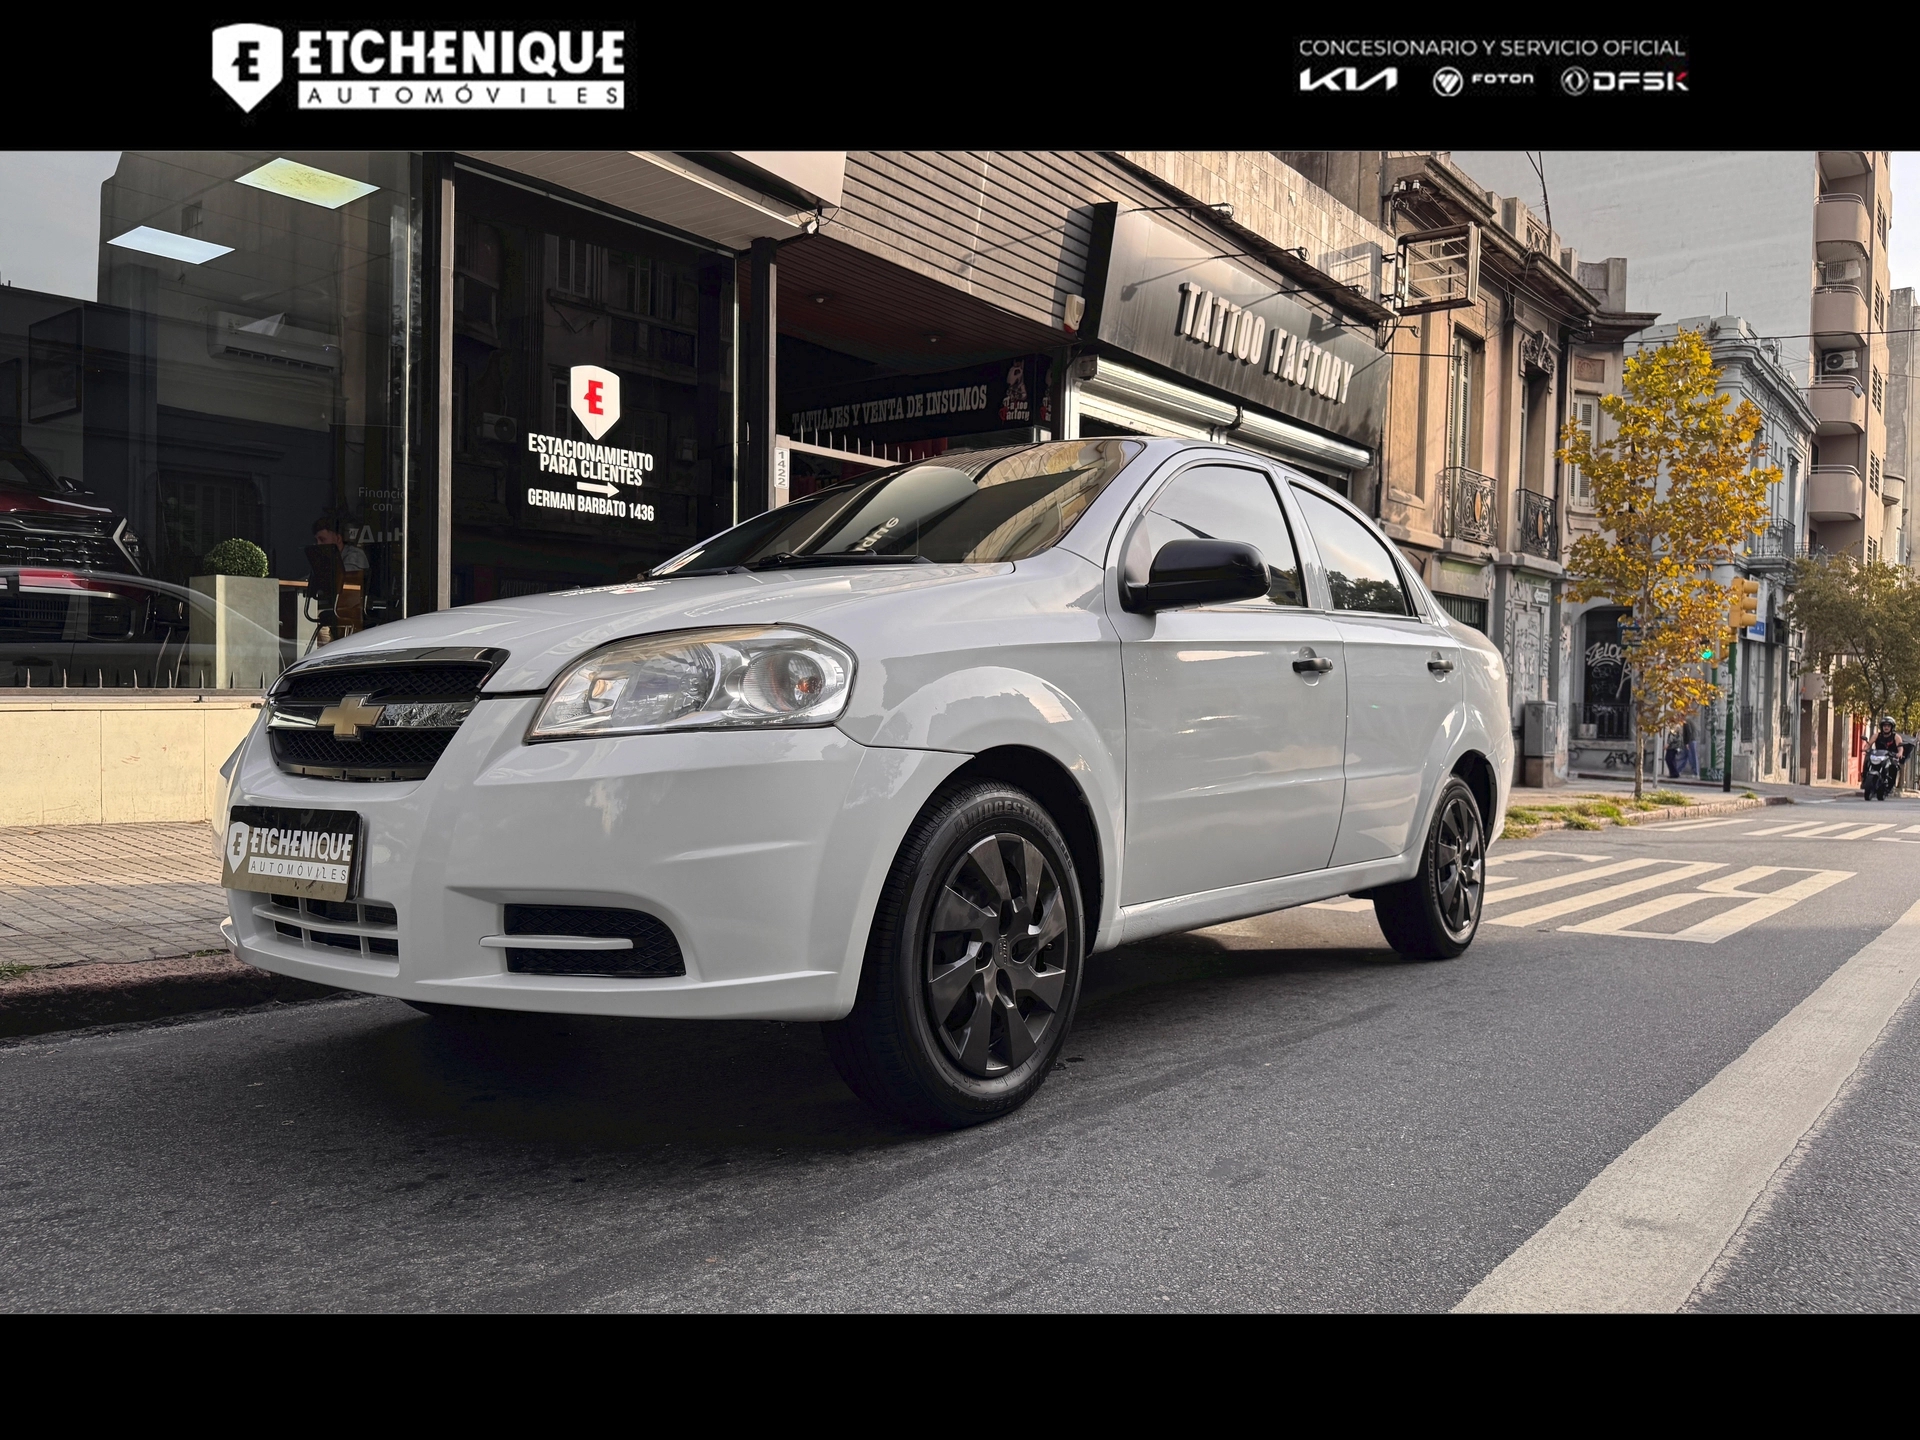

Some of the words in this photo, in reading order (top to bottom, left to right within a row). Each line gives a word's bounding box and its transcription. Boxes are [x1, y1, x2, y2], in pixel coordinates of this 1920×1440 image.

[1181, 281, 1266, 365] TATTOO
[1269, 327, 1354, 404] FACTORY
[791, 403, 850, 434] TATUAJES
[851, 404, 861, 426] Y
[861, 397, 905, 424] VENTA
[906, 394, 924, 419] DE
[925, 384, 988, 416] INSUMOS
[527, 432, 654, 472] ESTACIONAMIENTO
[539, 453, 578, 477] PARA
[580, 460, 643, 487] CLIENTES
[777, 450, 786, 487] 1422
[372, 502, 393, 512] con
[527, 488, 575, 511] GERMAN
[577, 495, 626, 518] BARBATO
[629, 503, 655, 522] 1436
[249, 826, 354, 863] ETCHENIQUE
[250, 862, 347, 881] AUTOMÓVILES
